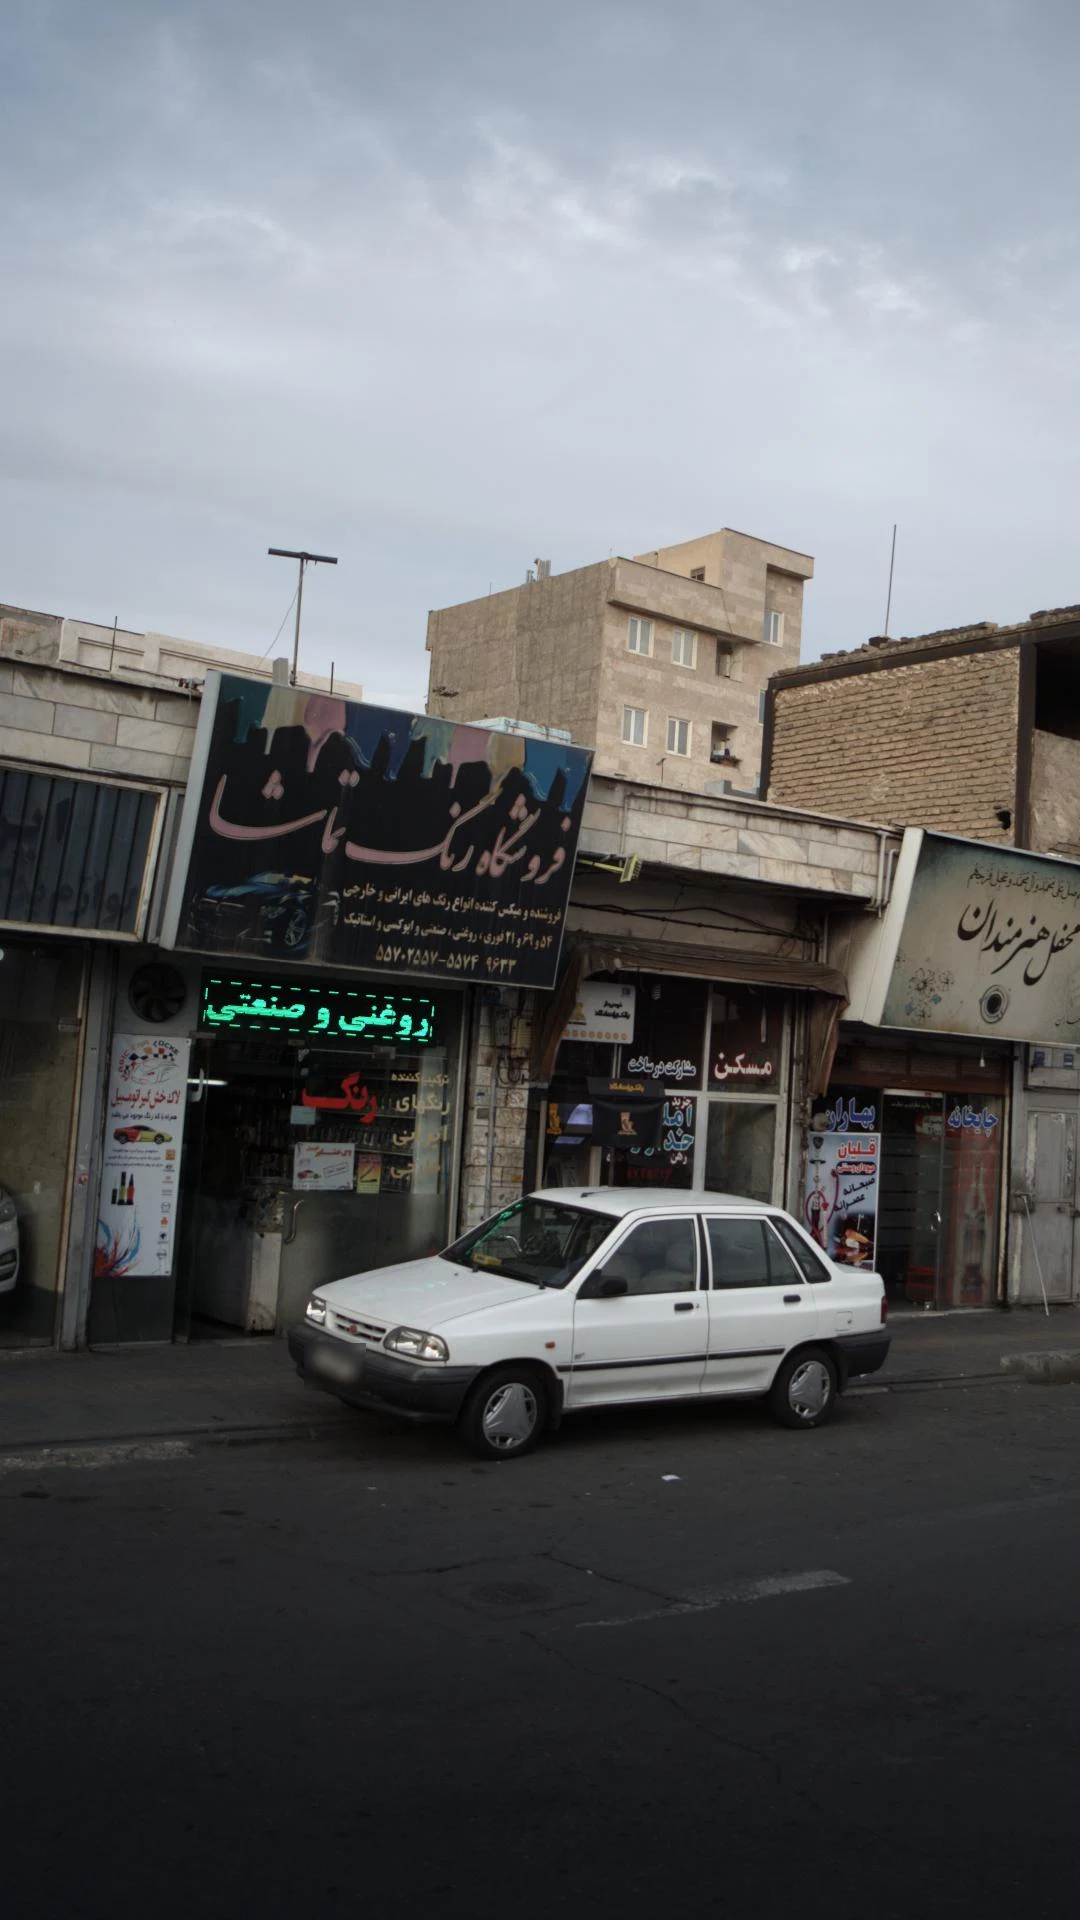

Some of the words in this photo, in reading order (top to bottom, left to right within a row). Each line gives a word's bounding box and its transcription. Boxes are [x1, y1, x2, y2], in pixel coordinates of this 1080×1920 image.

[209, 768, 361, 855] تماشا
[345, 789, 500, 873] رنگ
[475, 793, 574, 885] فروشگاه
[343, 882, 376, 900] خارجی
[376, 889, 384, 902] و
[384, 886, 414, 905] ایرانی
[413, 890, 432, 908] های
[433, 893, 451, 911] رنگ
[451, 896, 475, 913] انواع
[474, 899, 499, 913] کننده
[497, 903, 522, 918] میکس
[343, 912, 376, 928] استاتیک
[522, 909, 529, 921] و
[529, 907, 562, 926] فروشنده
[376, 920, 382, 932] و
[414, 925, 420, 936] و
[420, 923, 447, 936] صنعتی
[958, 898, 1050, 975] هنرمندان
[207, 993, 306, 1021] صنعتی
[313, 1007, 330, 1029] و
[338, 1003, 429, 1037] روغنی
[627, 1056, 655, 1072] ساخت
[652, 1061, 665, 1079] در
[664, 1059, 697, 1080] مشارکت
[714, 1051, 772, 1080] مسکن
[390, 1073, 421, 1083] کننده
[300, 1071, 378, 1125] رنگ
[824, 1096, 876, 1132] بهاران
[947, 1105, 998, 1138] چایخانه
[837, 1138, 876, 1159] قلیان
[669, 1152, 688, 1166] رهن
[843, 1177, 875, 1196] صبحانه
[833, 1194, 865, 1211] عصرانه
